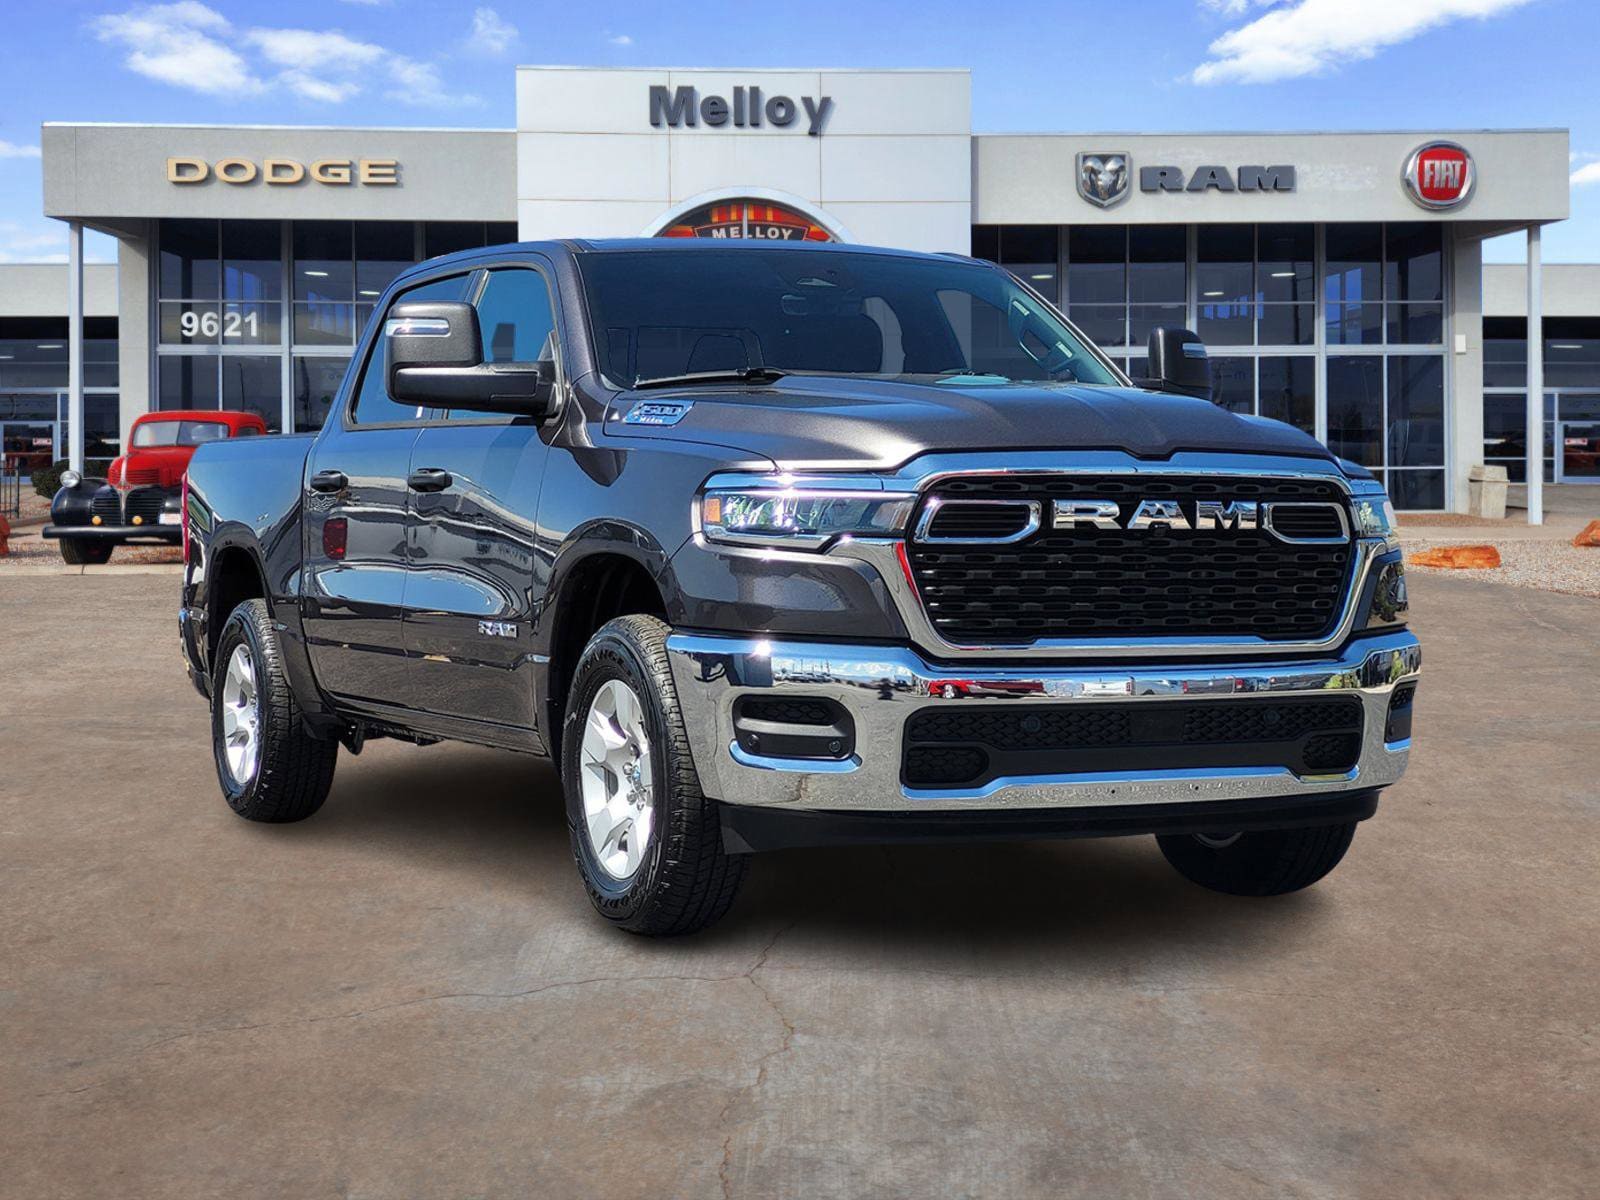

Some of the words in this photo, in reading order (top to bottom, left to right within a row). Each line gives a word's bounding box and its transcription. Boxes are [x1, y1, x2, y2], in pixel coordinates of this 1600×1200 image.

[649, 85, 832, 136] Melloy
[167, 157, 398, 185] DODGE
[1140, 164, 1296, 192] RAM
[1423, 159, 1468, 189] FIAT
[180, 311, 258, 337] 9621
[1052, 499, 1258, 530] RAM
